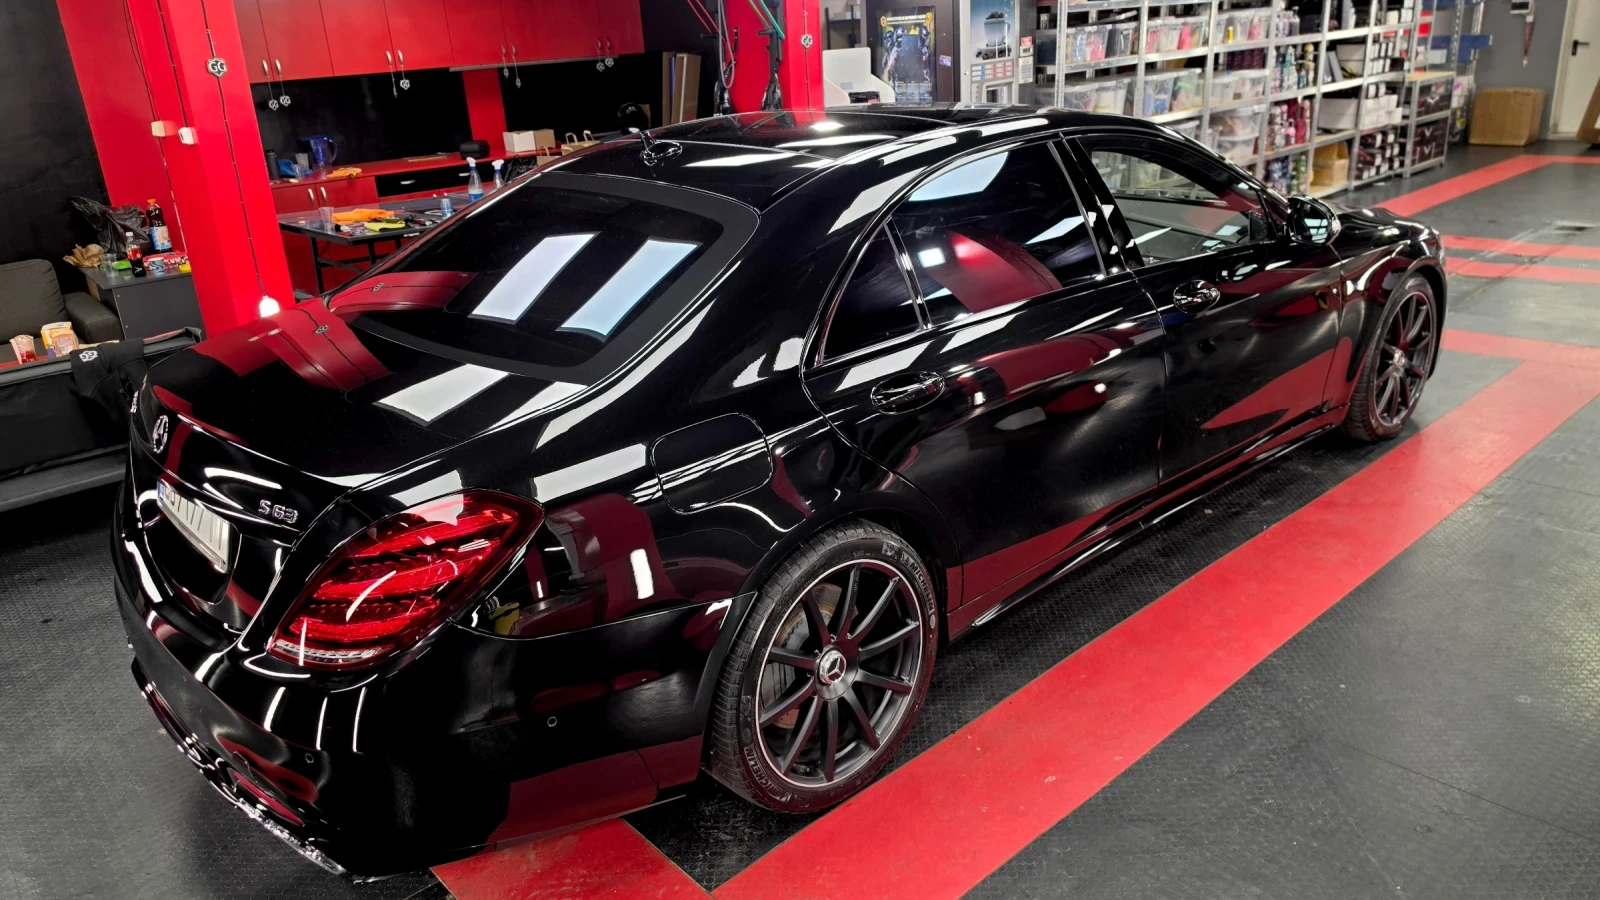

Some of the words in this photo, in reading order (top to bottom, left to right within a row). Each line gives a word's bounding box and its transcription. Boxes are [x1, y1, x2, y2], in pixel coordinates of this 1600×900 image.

[209, 61, 227, 72] GG
[272, 505, 298, 523] 63
[909, 562, 935, 614] MICHELIN
